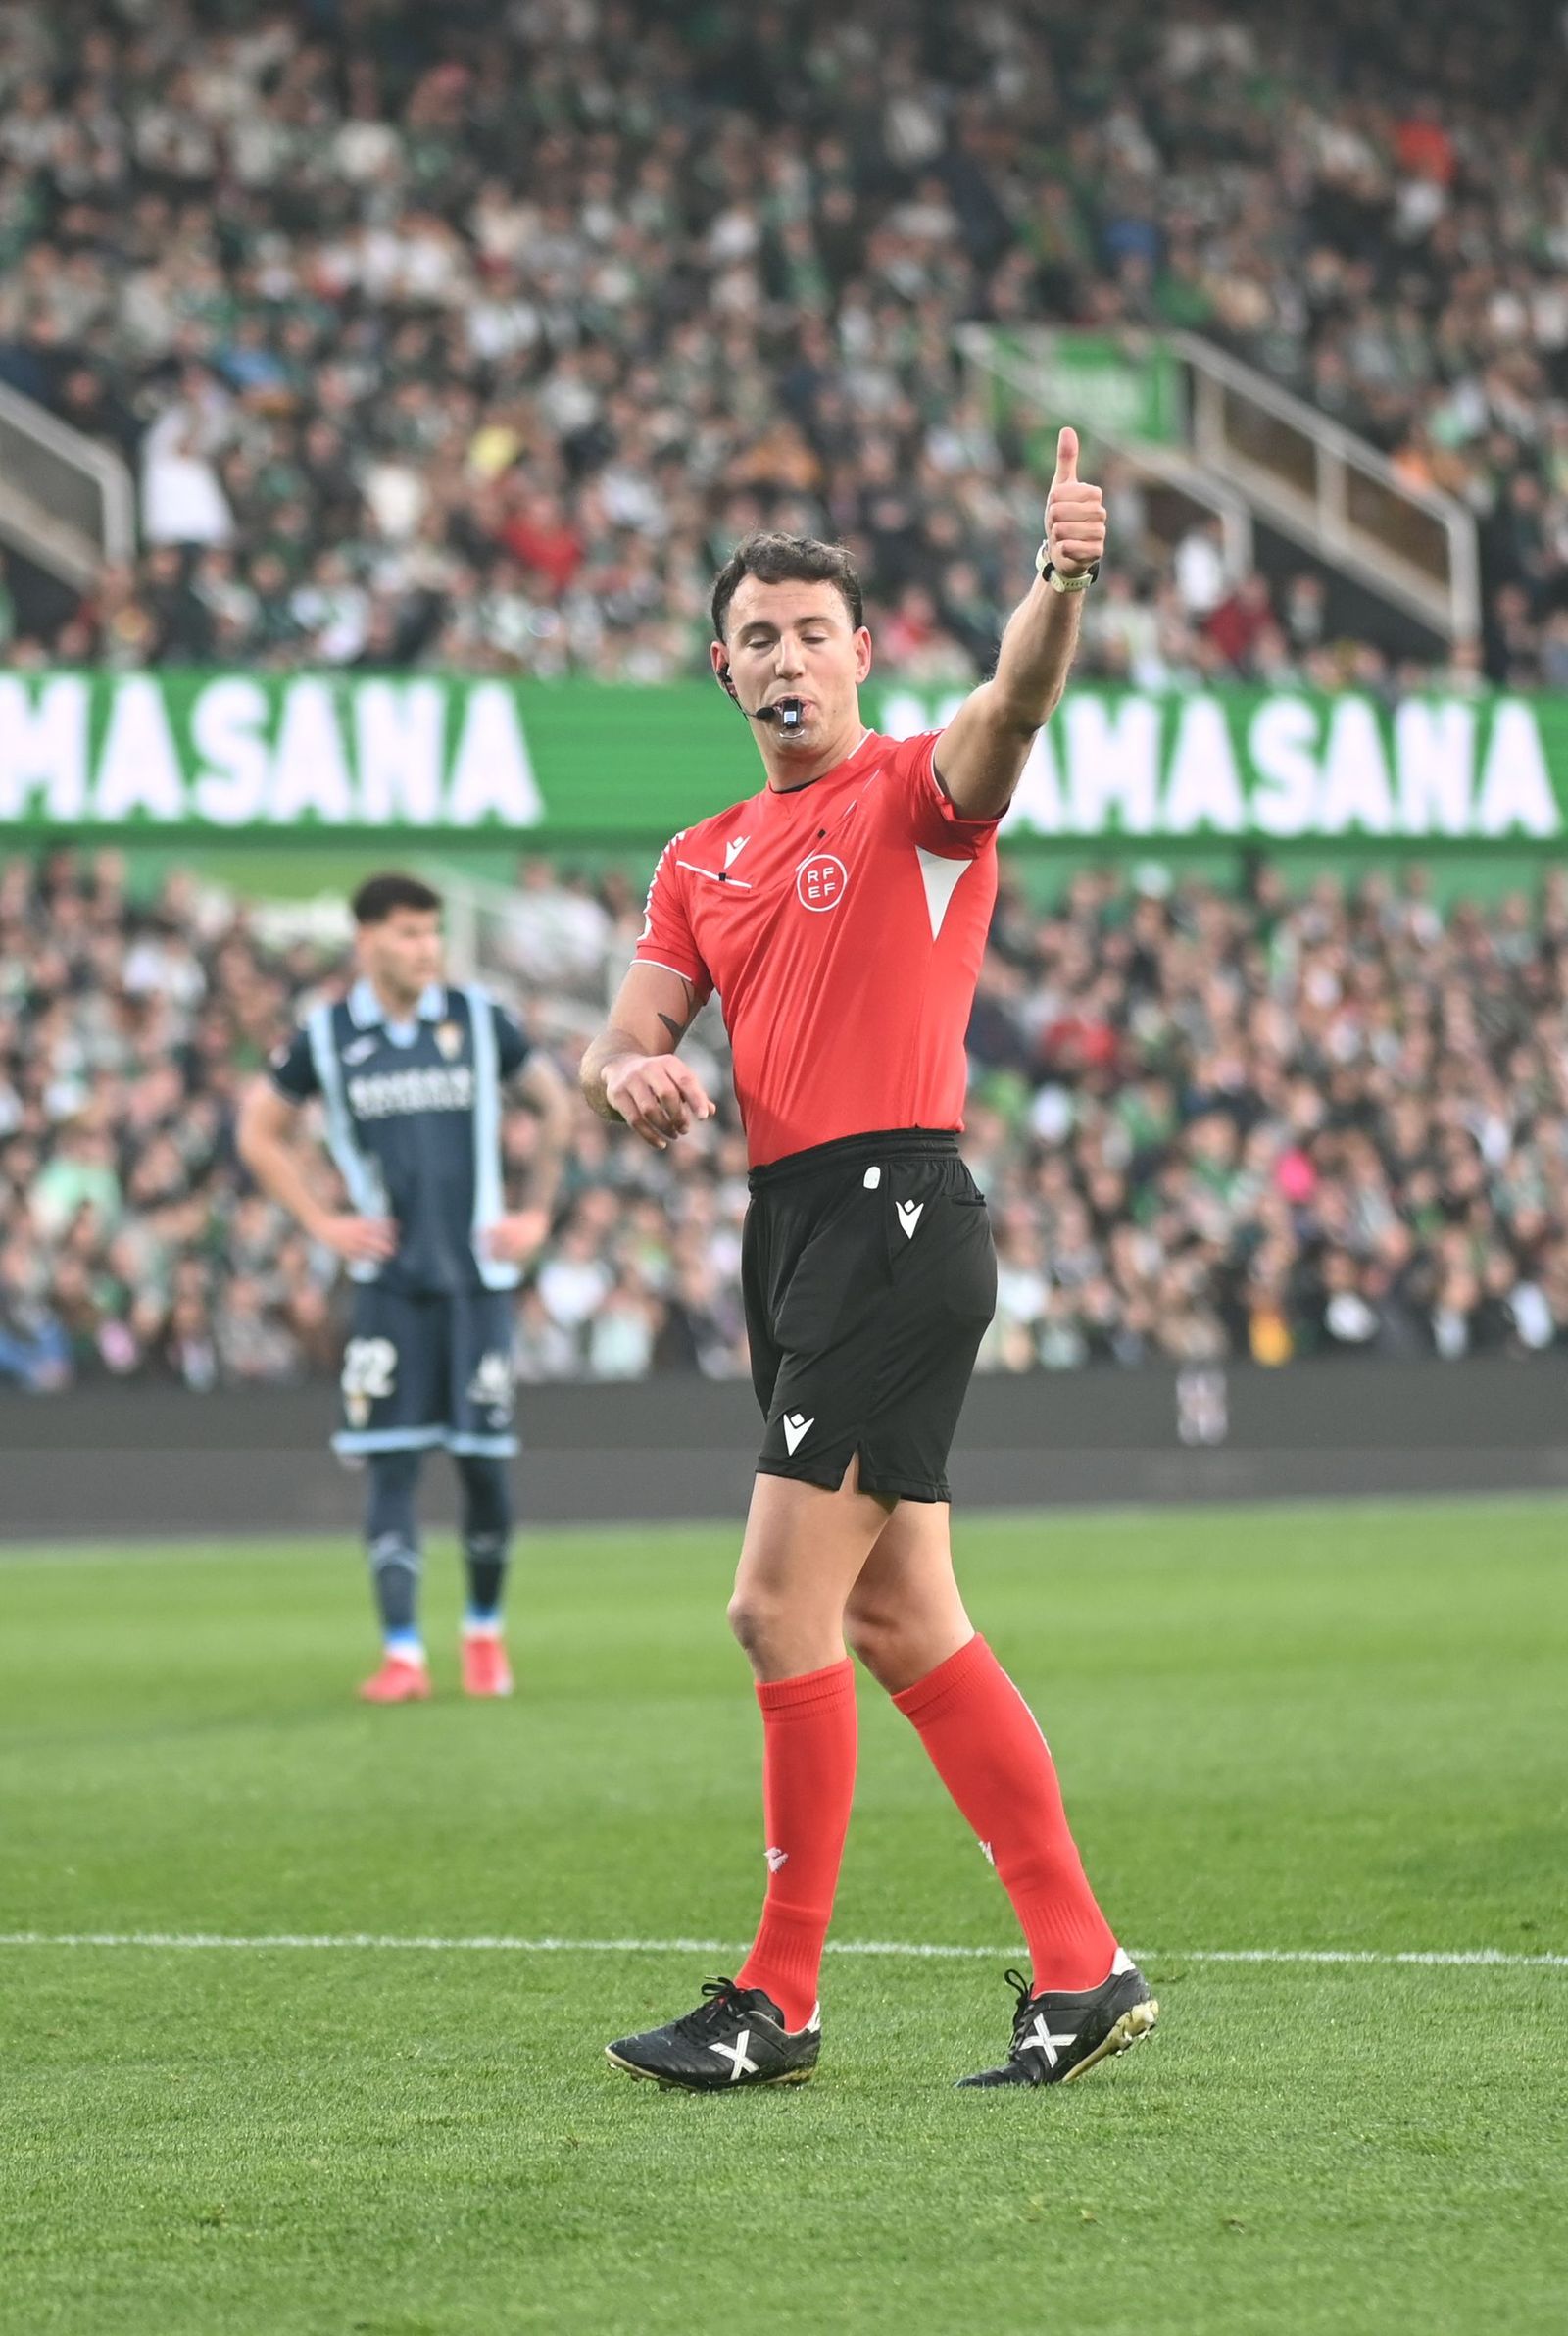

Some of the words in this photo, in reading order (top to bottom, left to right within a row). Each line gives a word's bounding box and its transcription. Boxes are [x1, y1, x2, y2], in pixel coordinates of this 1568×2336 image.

[0, 674, 543, 828] MASANA
[884, 692, 1562, 839] AMASANA
[807, 866, 835, 883] RF
[808, 882, 836, 899] EF
